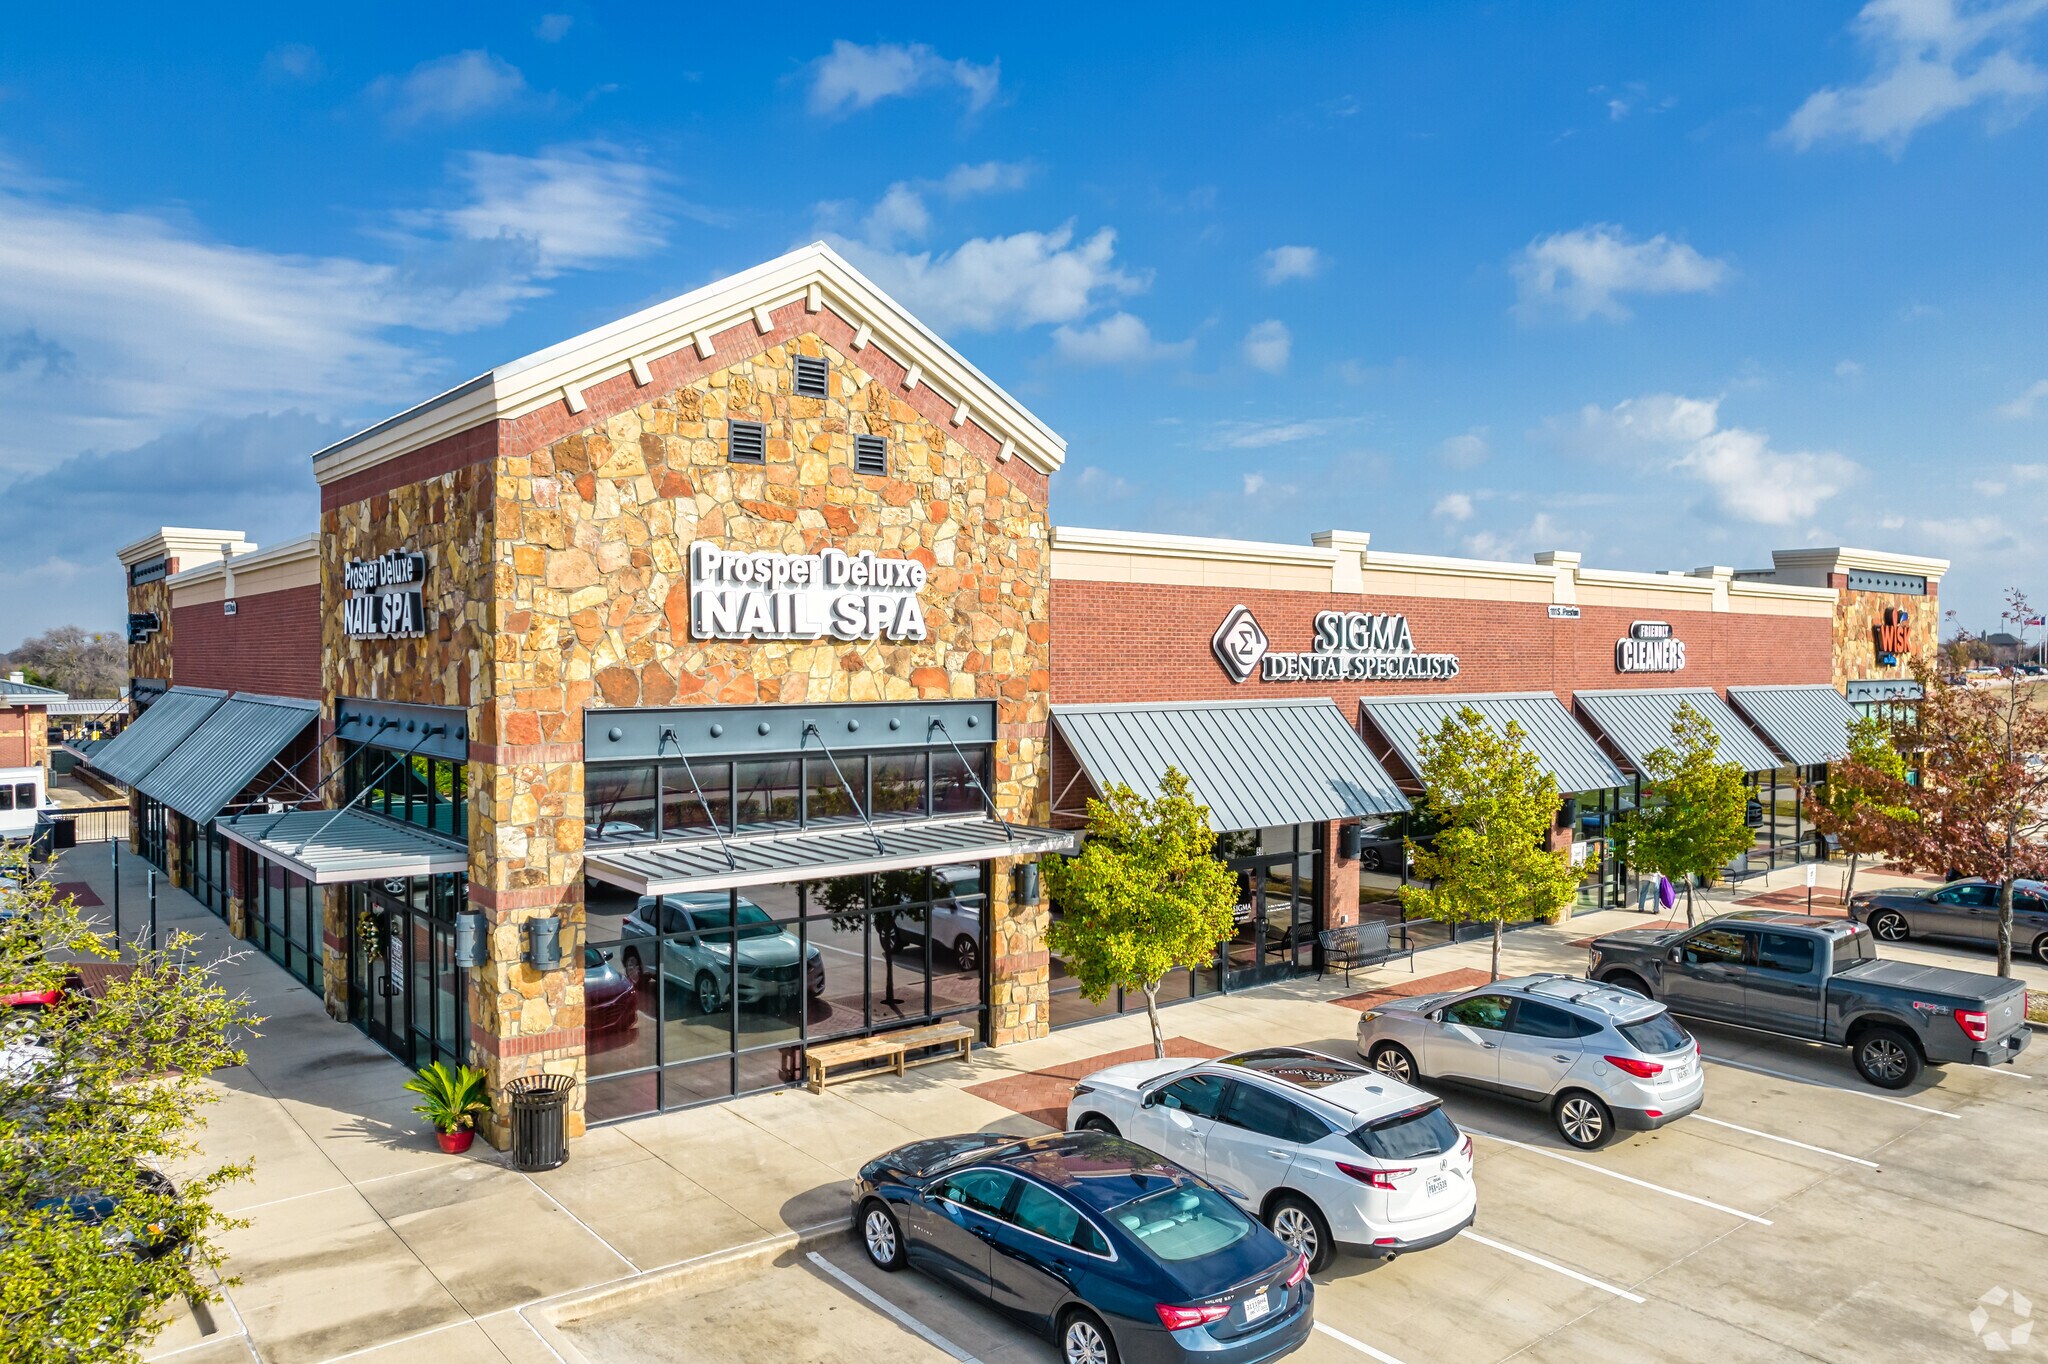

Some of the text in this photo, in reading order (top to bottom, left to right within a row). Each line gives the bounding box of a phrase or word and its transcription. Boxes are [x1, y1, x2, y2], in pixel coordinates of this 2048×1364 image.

[345, 553, 413, 594] Prosper Deluxe
[701, 546, 926, 590] Prosper Deluxe
[344, 592, 413, 635] NAIL SPA
[701, 591, 925, 636] NAIL SPA
[1322, 613, 1416, 650] SIGMA
[1641, 625, 1669, 638] FRIENDLY
[1270, 656, 1459, 677] DENTAL SPECIALISTS
[1623, 641, 1686, 670] CLEANERS
